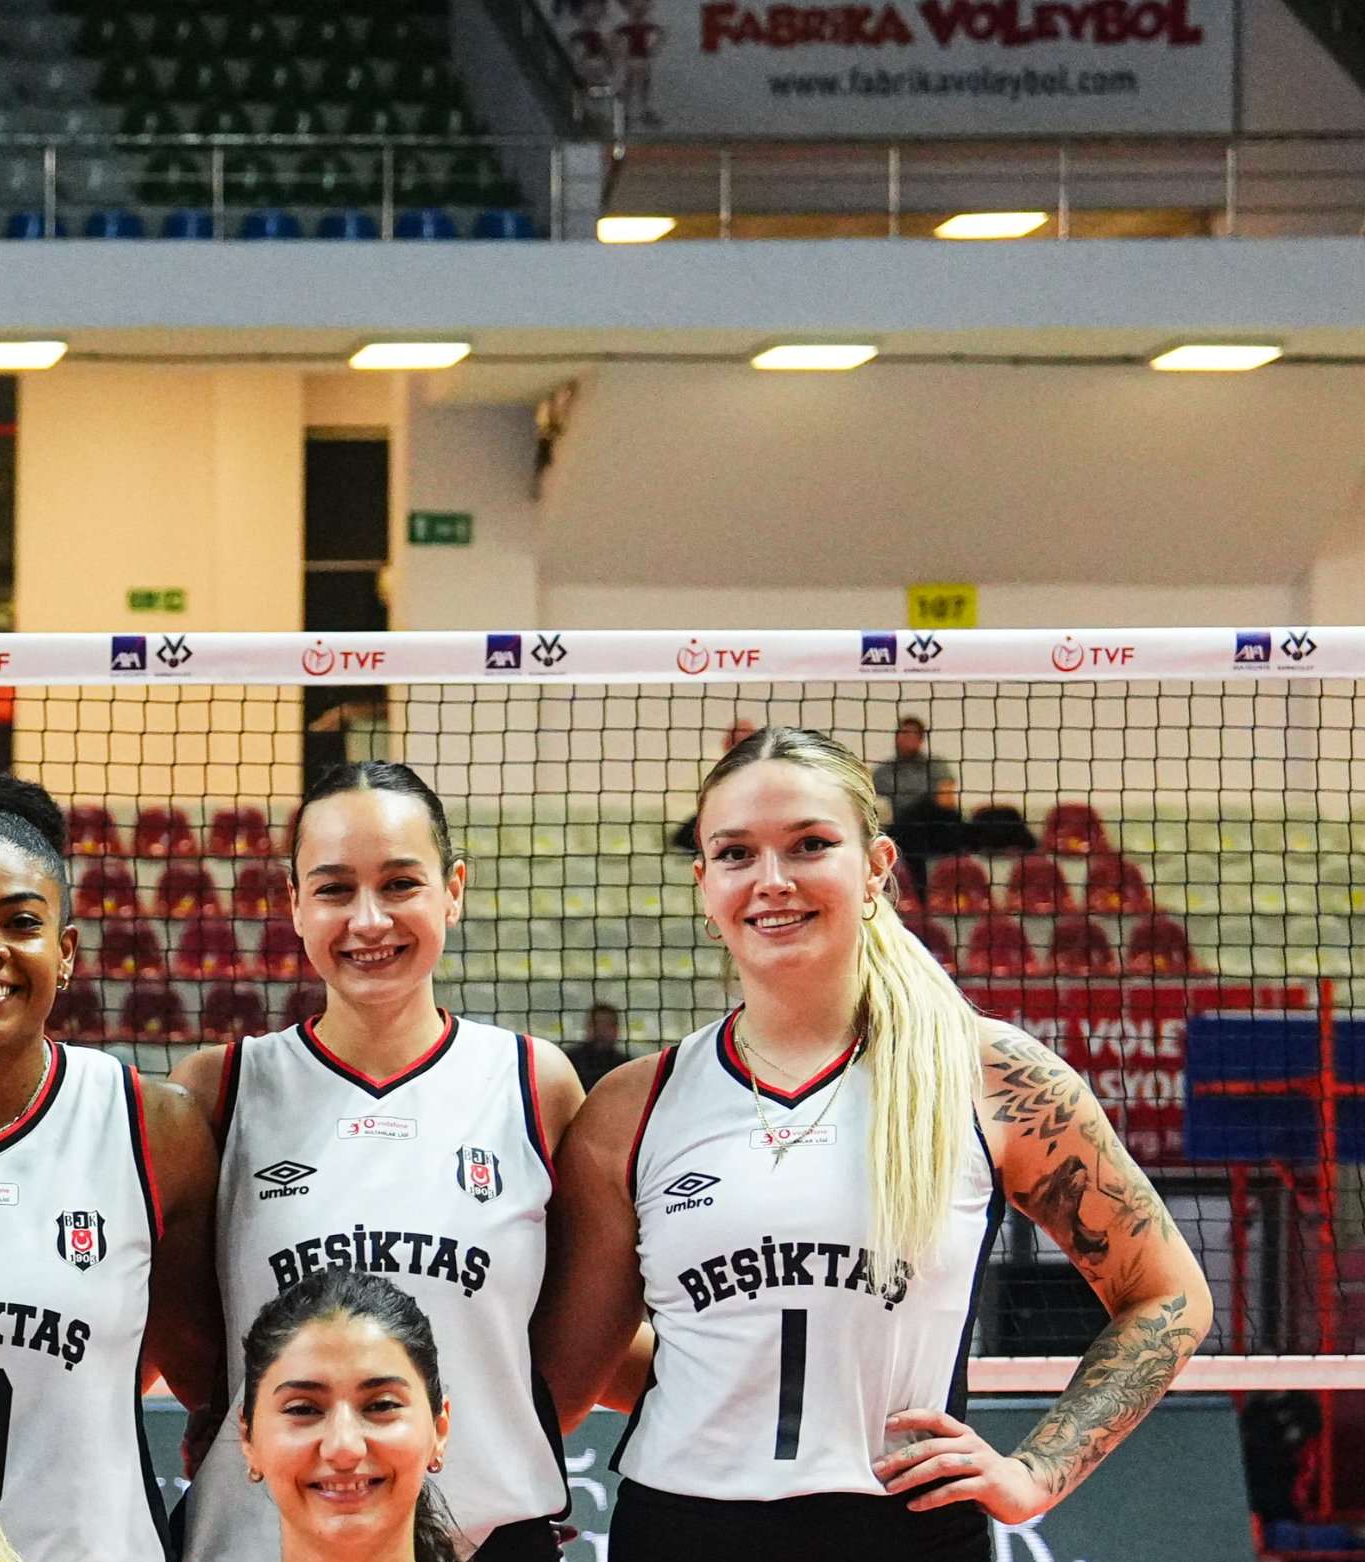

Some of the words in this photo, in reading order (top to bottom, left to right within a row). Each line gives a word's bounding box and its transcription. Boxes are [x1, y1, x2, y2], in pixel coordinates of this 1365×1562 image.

[341, 650, 388, 671] TVF
[716, 649, 761, 669] TVF
[1091, 647, 1135, 666] TVF
[259, 1185, 309, 1200] umbro
[665, 1196, 714, 1215] umbro
[65, 1213, 97, 1228] BJK
[70, 1253, 97, 1264] 1903
[773, 1309, 809, 1460] 1
